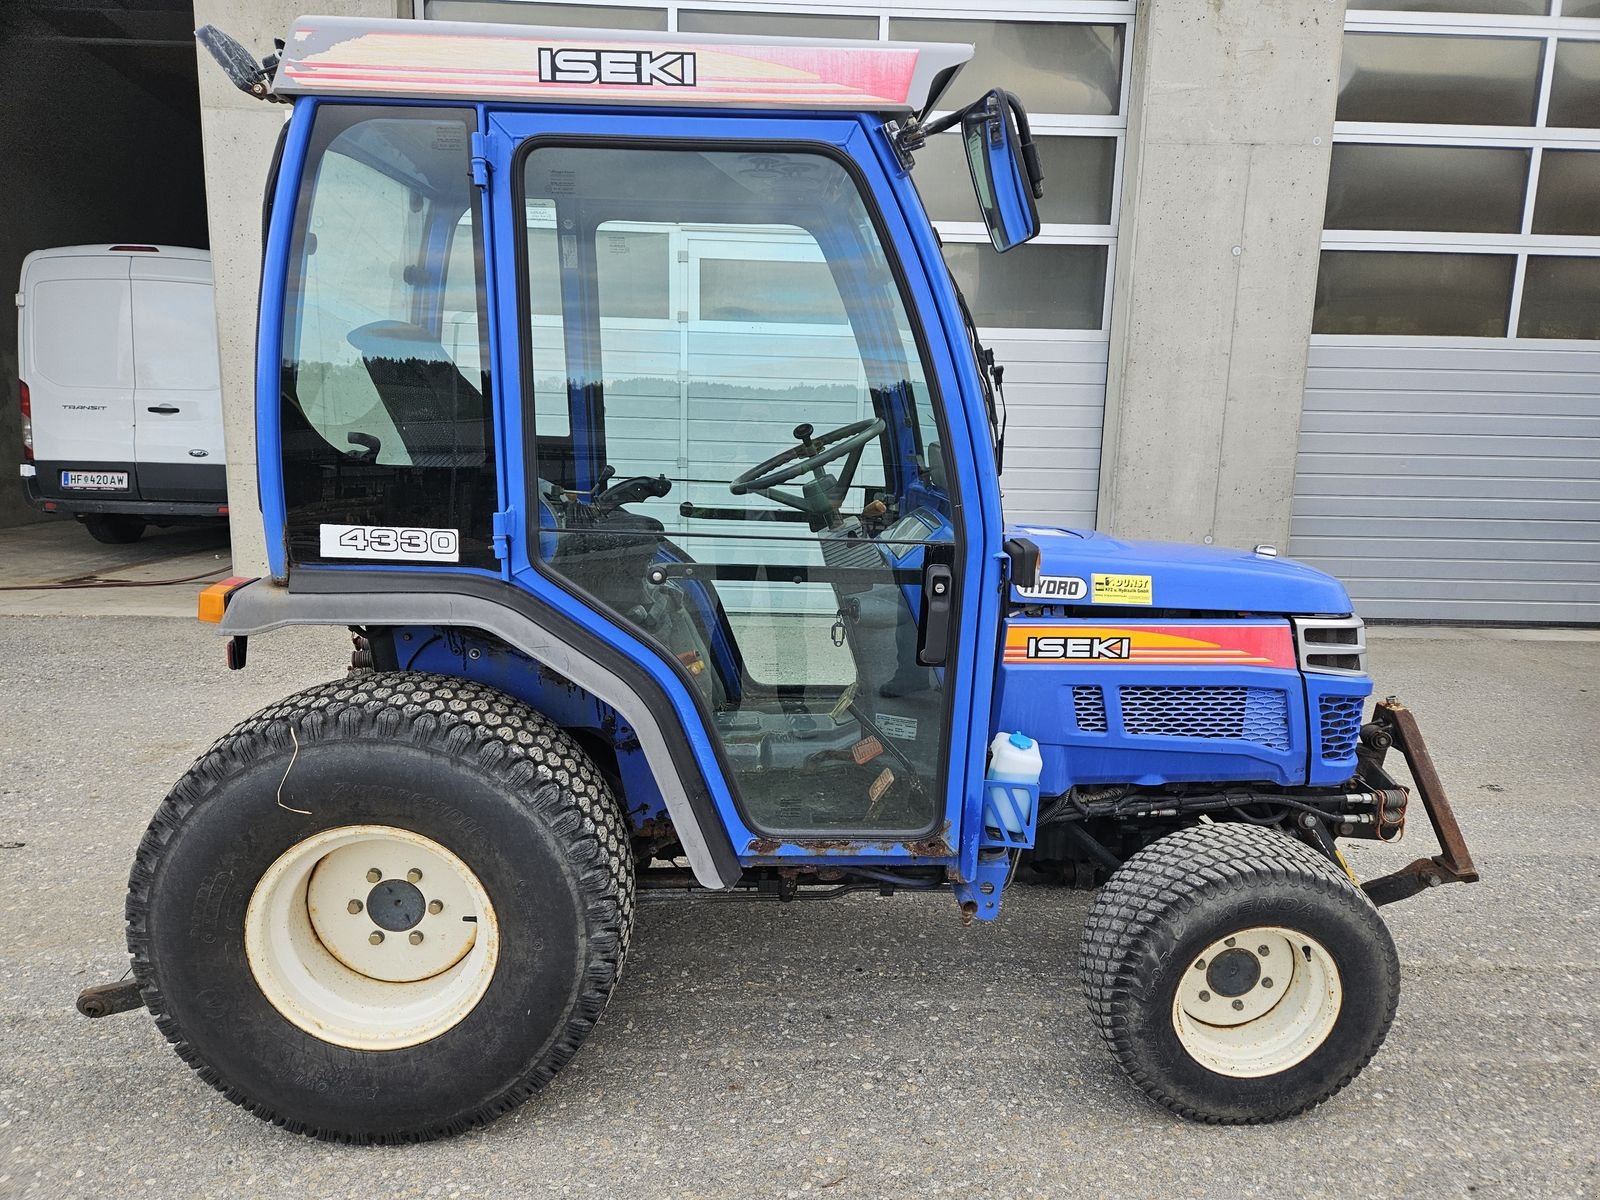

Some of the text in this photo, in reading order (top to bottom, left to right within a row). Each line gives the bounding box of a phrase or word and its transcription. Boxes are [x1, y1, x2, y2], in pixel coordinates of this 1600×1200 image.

[538, 47, 696, 86] ISEKI
[70, 474, 82, 484] HF
[339, 528, 457, 554] 4330
[1027, 637, 1131, 659] ISEKI
[1214, 896, 1318, 925] KENDA
